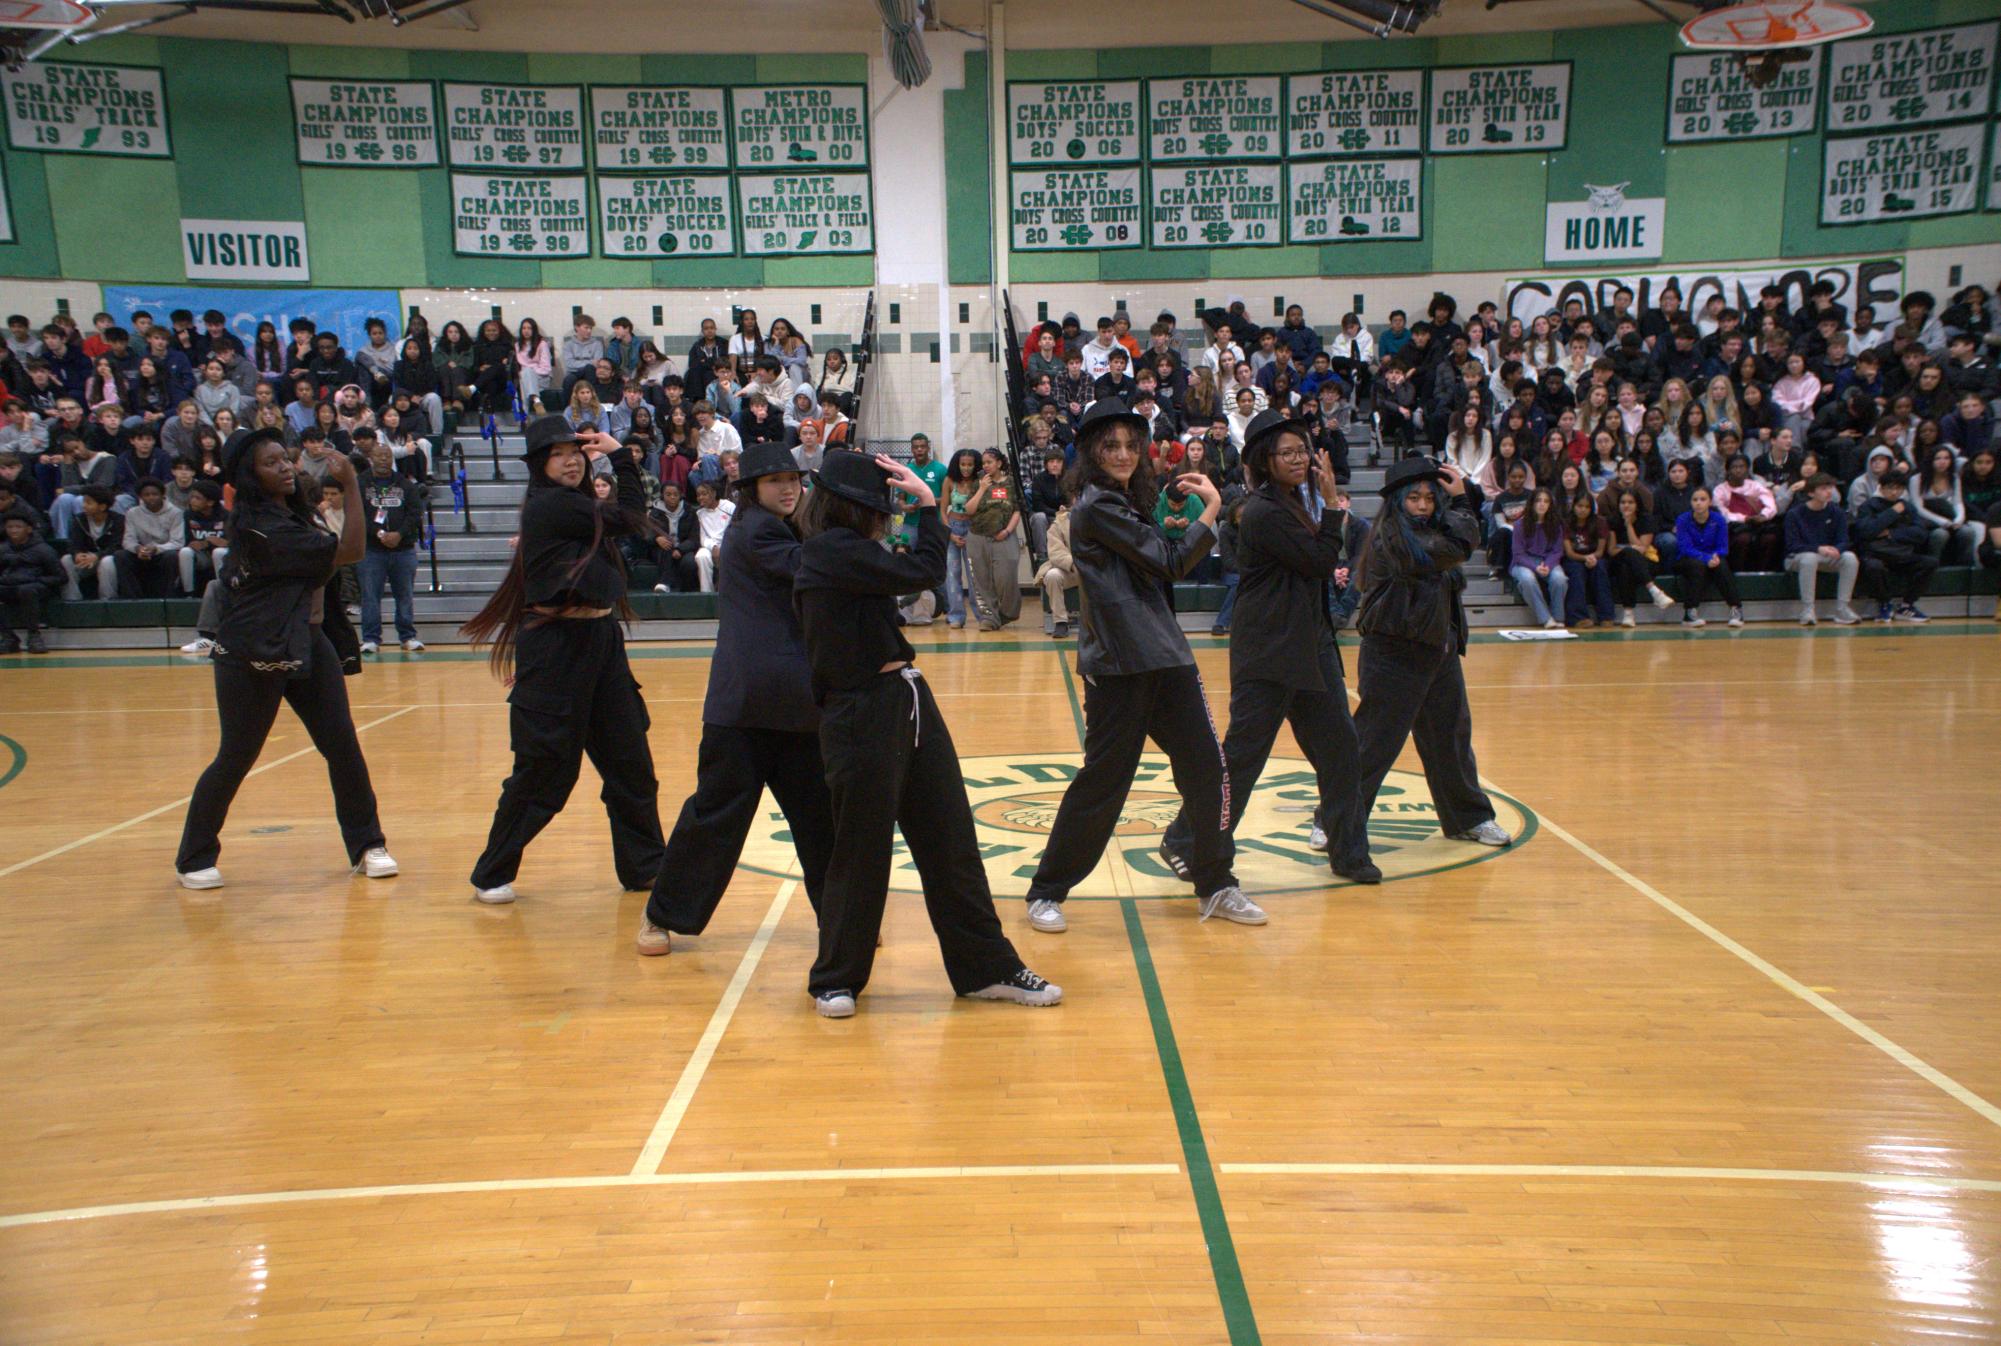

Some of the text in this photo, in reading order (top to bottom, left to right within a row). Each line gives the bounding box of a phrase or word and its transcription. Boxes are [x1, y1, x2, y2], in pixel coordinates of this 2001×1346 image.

[1872, 33, 1955, 61] STATE
[1840, 49, 1984, 82] CHAMPIONS
[46, 67, 119, 88] STATE
[1322, 74, 1389, 93] STATE
[1469, 70, 1532, 89] STATE
[1682, 69, 1810, 95] CHAMNS
[12, 82, 155, 108] CHAMPIONS
[330, 85, 397, 104] STATE
[481, 88, 546, 108] STATE
[765, 90, 831, 107] METRO
[1044, 85, 1106, 103] STATE
[1183, 80, 1247, 98] STATE
[1443, 87, 1558, 107] CHAMPIONS
[627, 91, 690, 108] STATE
[1158, 97, 1272, 117] CHAMPIONS
[1296, 91, 1413, 112] CHAMPIONS
[1717, 92, 1753, 111] CROSS
[1760, 88, 1813, 109] COUNTRY
[1842, 104, 1871, 123] 20
[1946, 91, 1973, 111] 14
[96, 107, 158, 128] TRACK
[304, 104, 428, 124] CHAMPIONS
[454, 107, 574, 127] CHAMPIONS
[601, 110, 718, 128] CHAMPIONS
[741, 107, 857, 125] CHAMPIONS
[1017, 102, 1132, 121] CHAMPIONS
[1328, 111, 1362, 128] CROSS
[1370, 109, 1418, 127] COUNTRY
[1483, 106, 1516, 123] SWIM
[1524, 104, 1561, 121] TEAM
[1075, 119, 1134, 138] SOCCER
[1190, 116, 1222, 132] CROSS
[1230, 115, 1278, 132] COUNTRY
[1684, 116, 1710, 133] 20
[1770, 110, 1793, 128] 13
[35, 125, 150, 148] 19 93
[344, 125, 377, 140] CROSS
[386, 126, 432, 140] COUNTRY
[494, 128, 525, 142] CROSS
[534, 130, 580, 144] COUNTRY
[639, 130, 669, 144] CROSS
[679, 130, 722, 144] COUNTRY
[781, 125, 812, 142] SWIM
[832, 124, 862, 141] DIVE
[1300, 132, 1324, 149] 20
[1384, 129, 1400, 146] 11
[1446, 125, 1545, 146] 20 13
[326, 143, 346, 160] 19
[392, 144, 417, 161] 96
[474, 145, 494, 161] 19
[539, 147, 562, 164] 97
[751, 144, 853, 162] 20 00
[1031, 139, 1121, 157] 20 06
[1163, 137, 1187, 155] 20
[1244, 135, 1268, 152] 09
[1866, 133, 1939, 157] STATE
[620, 148, 640, 164] 19
[683, 147, 708, 164] 99
[1837, 147, 1968, 177] CHAMPIONS
[1045, 172, 1108, 190] STATE
[1185, 168, 1248, 187] STATE
[1324, 163, 1385, 182] STATE
[1880, 172, 1920, 192] SWIM
[1930, 165, 1972, 187] TEAM
[488, 180, 552, 197] STATE
[633, 179, 695, 196] STATE
[773, 177, 834, 195] STATE
[1160, 186, 1273, 205] CHAMPIONS
[1300, 179, 1410, 199] CHAMPIONS
[461, 197, 580, 216] CHAMPIONS
[607, 196, 723, 214] CHAMPIONS
[748, 195, 862, 213] CHAMPIONS
[1020, 188, 1133, 207] CHAMPIONS
[1339, 197, 1372, 214] SWIM
[1380, 196, 1414, 213] TEAM
[1839, 189, 1952, 216] 20 15
[666, 214, 726, 231] SOCCER
[784, 213, 818, 228] TRACK
[838, 212, 868, 227] FIELD
[1052, 208, 1084, 224] CROSS
[1091, 205, 1139, 223] COUNTRY
[1191, 205, 1224, 222] CROSS
[1231, 204, 1279, 220] COUNTRY
[500, 218, 531, 232] CROSS
[540, 217, 585, 232] COUNTRY
[1026, 228, 1048, 244] 20
[1106, 224, 1128, 241] 08
[1164, 226, 1188, 242] 20
[1245, 223, 1265, 240] 10
[1305, 216, 1400, 236] 20 12
[1567, 215, 1645, 250] HOME
[480, 234, 500, 251] 19
[546, 235, 570, 252] 98
[623, 234, 713, 251] 20 00
[763, 230, 852, 249] 20 03
[187, 232, 301, 268] VISITOR
